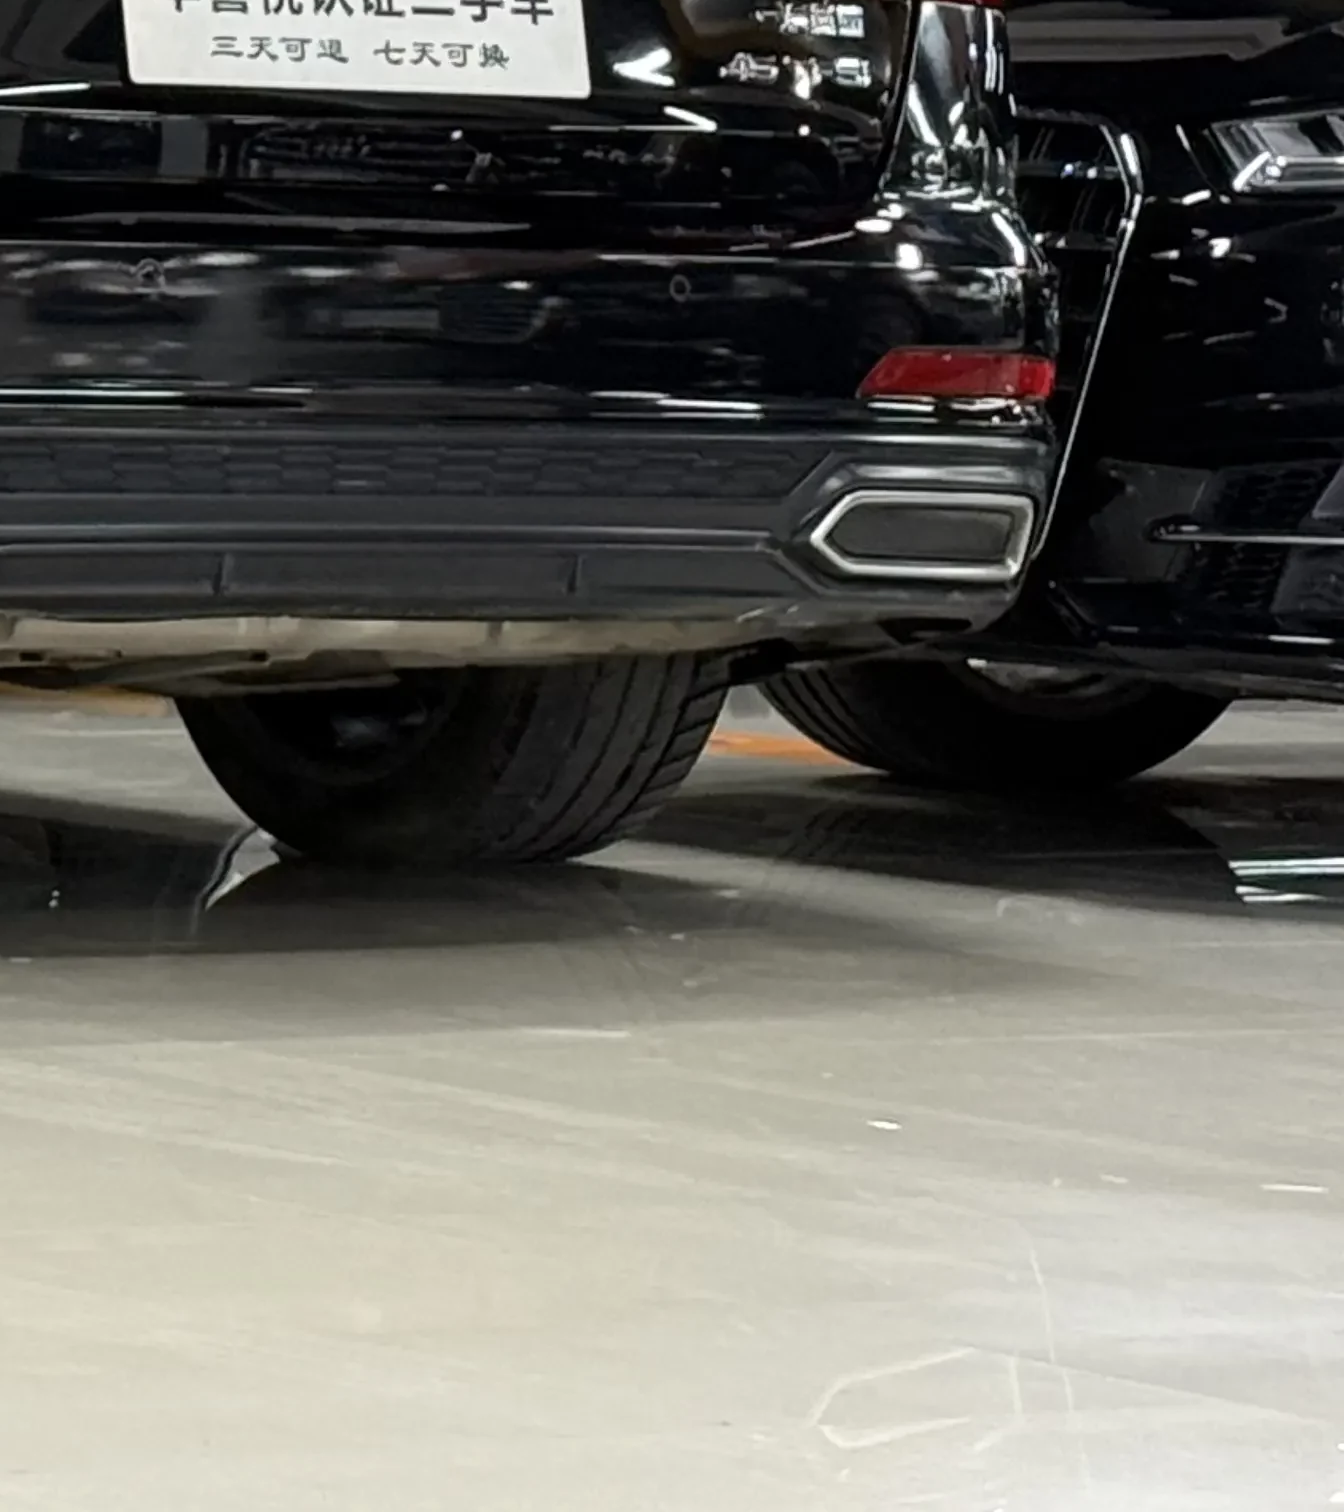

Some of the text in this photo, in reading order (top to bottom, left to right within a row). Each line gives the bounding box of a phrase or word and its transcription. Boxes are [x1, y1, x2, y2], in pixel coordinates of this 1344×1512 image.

[209, 34, 512, 72] 三天可退 七天可换
